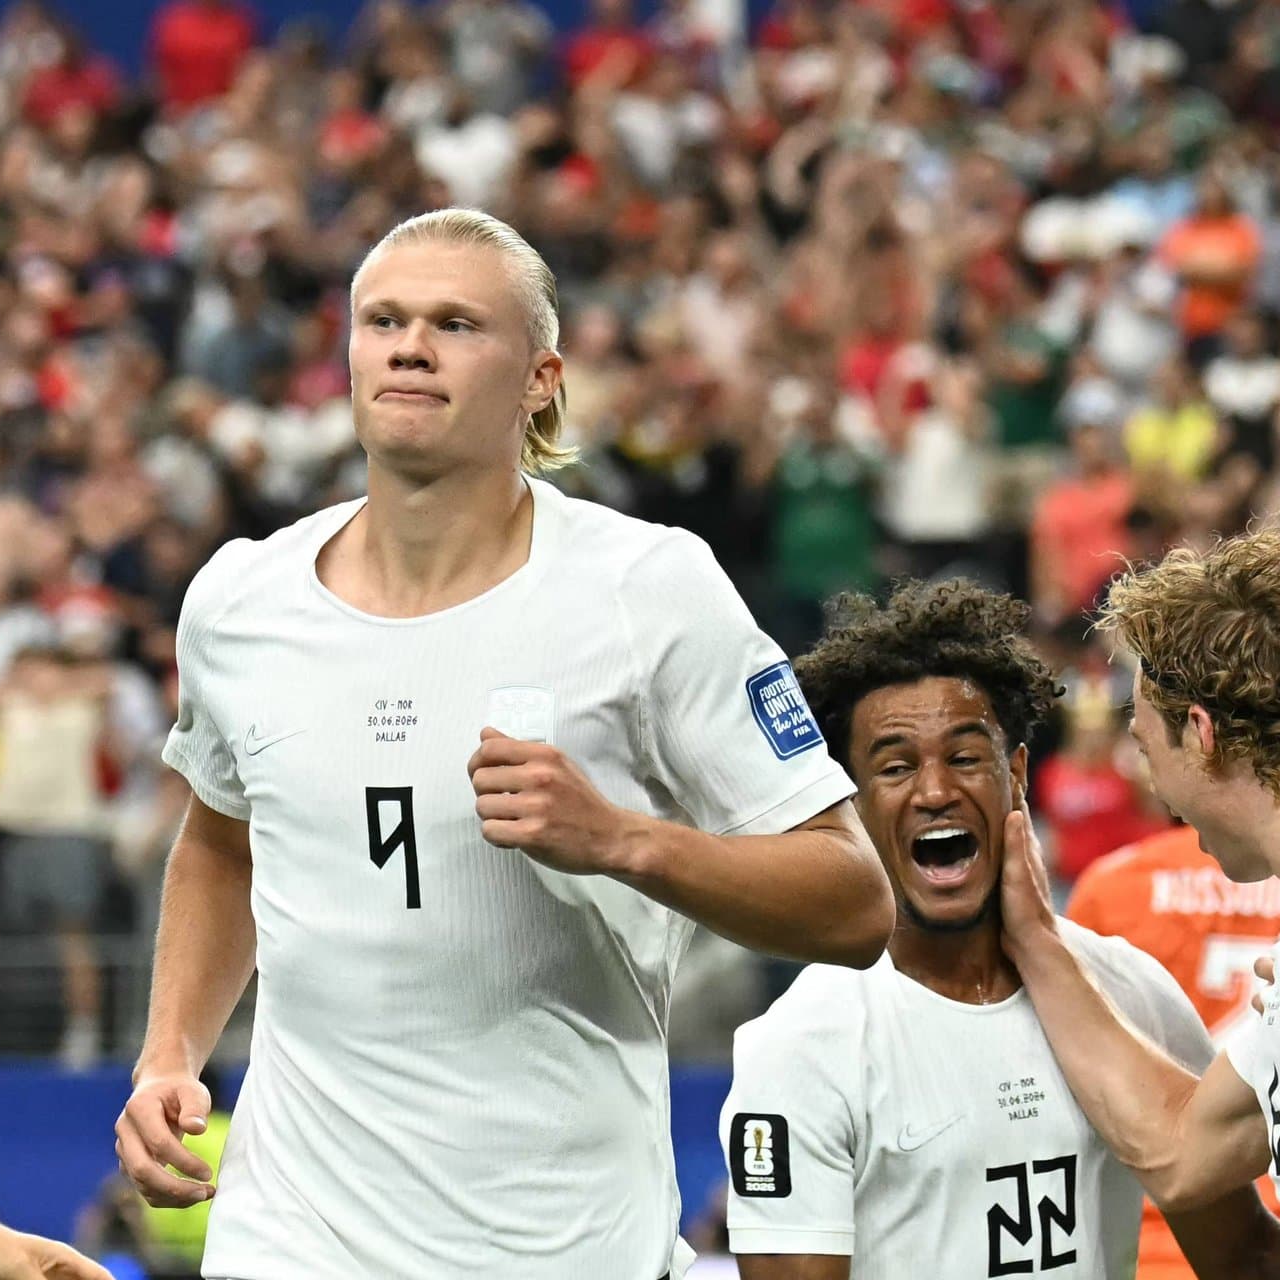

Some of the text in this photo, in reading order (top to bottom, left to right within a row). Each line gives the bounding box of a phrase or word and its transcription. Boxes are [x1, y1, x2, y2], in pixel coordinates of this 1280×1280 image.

[375, 731, 406, 742] DALLAS
[792, 724, 812, 738] FIFA
[365, 786, 421, 909] 9
[986, 1154, 1077, 1278] 22
